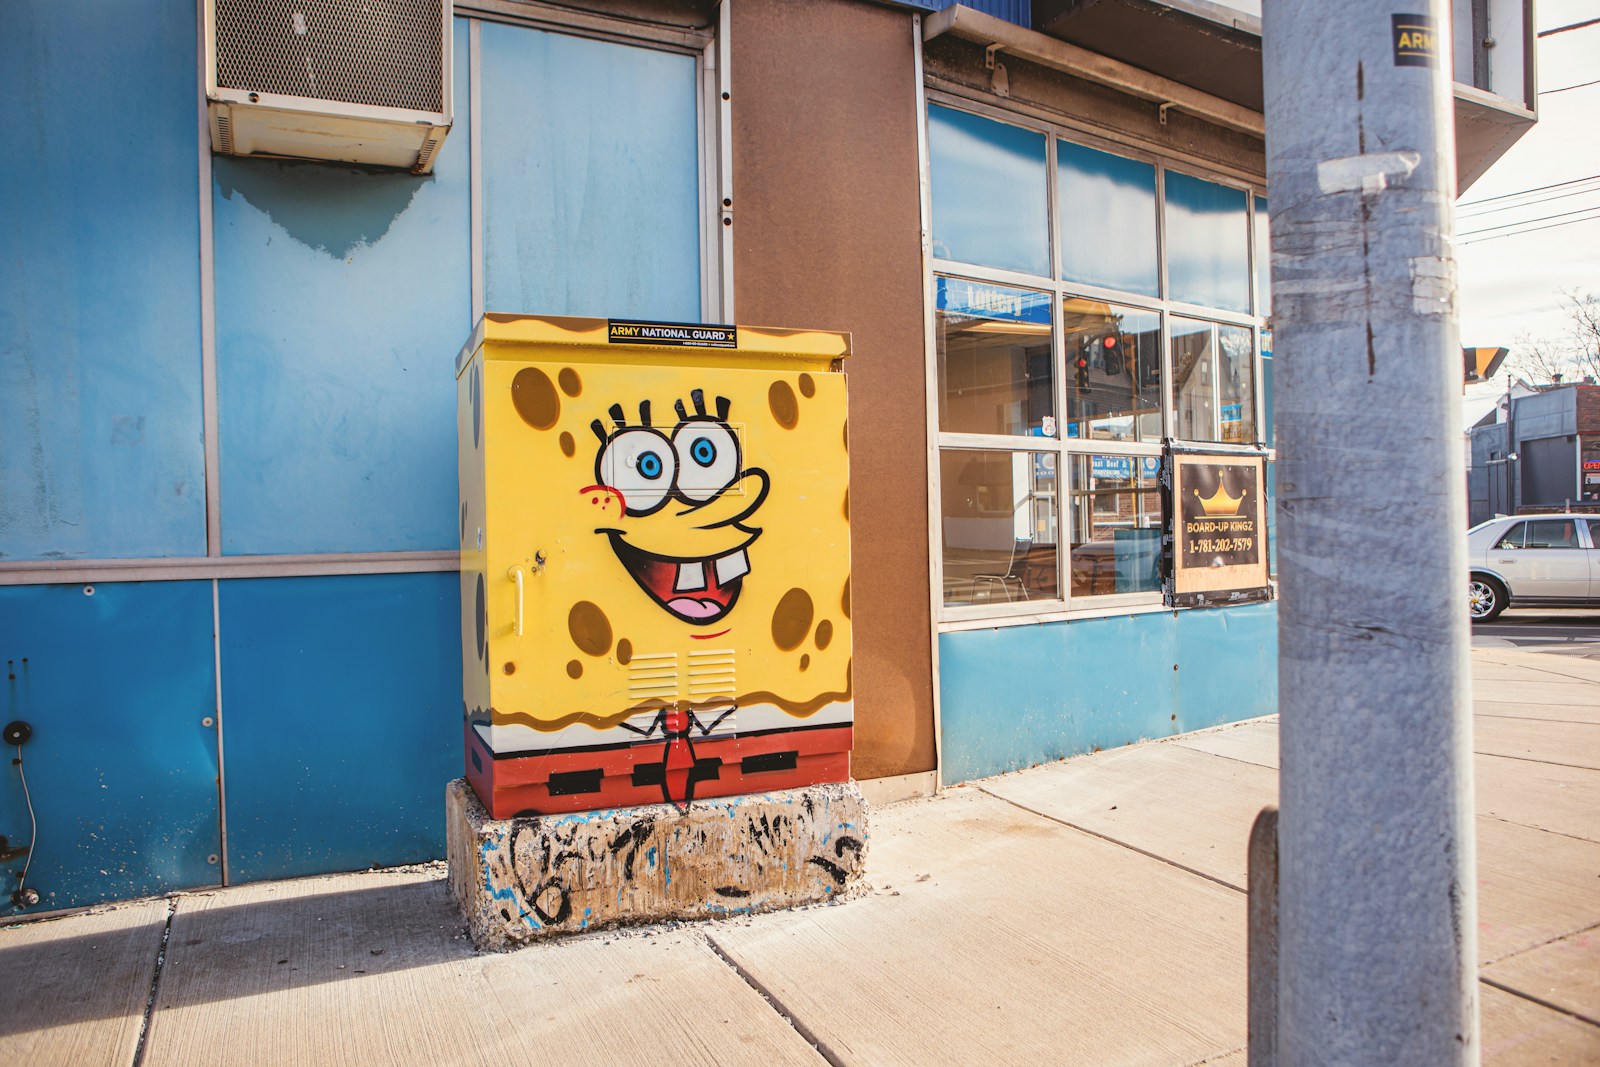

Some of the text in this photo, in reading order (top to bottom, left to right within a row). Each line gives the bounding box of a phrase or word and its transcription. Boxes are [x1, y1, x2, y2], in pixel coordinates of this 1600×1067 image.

[967, 285, 1022, 317] Lottery
[610, 326, 726, 340] ARMY NATIONAL GUARD
[1583, 461, 1600, 470] OPE
[1187, 521, 1253, 533] BOARD-UP KINGZ
[1189, 537, 1253, 554] 1-781-202-7579
